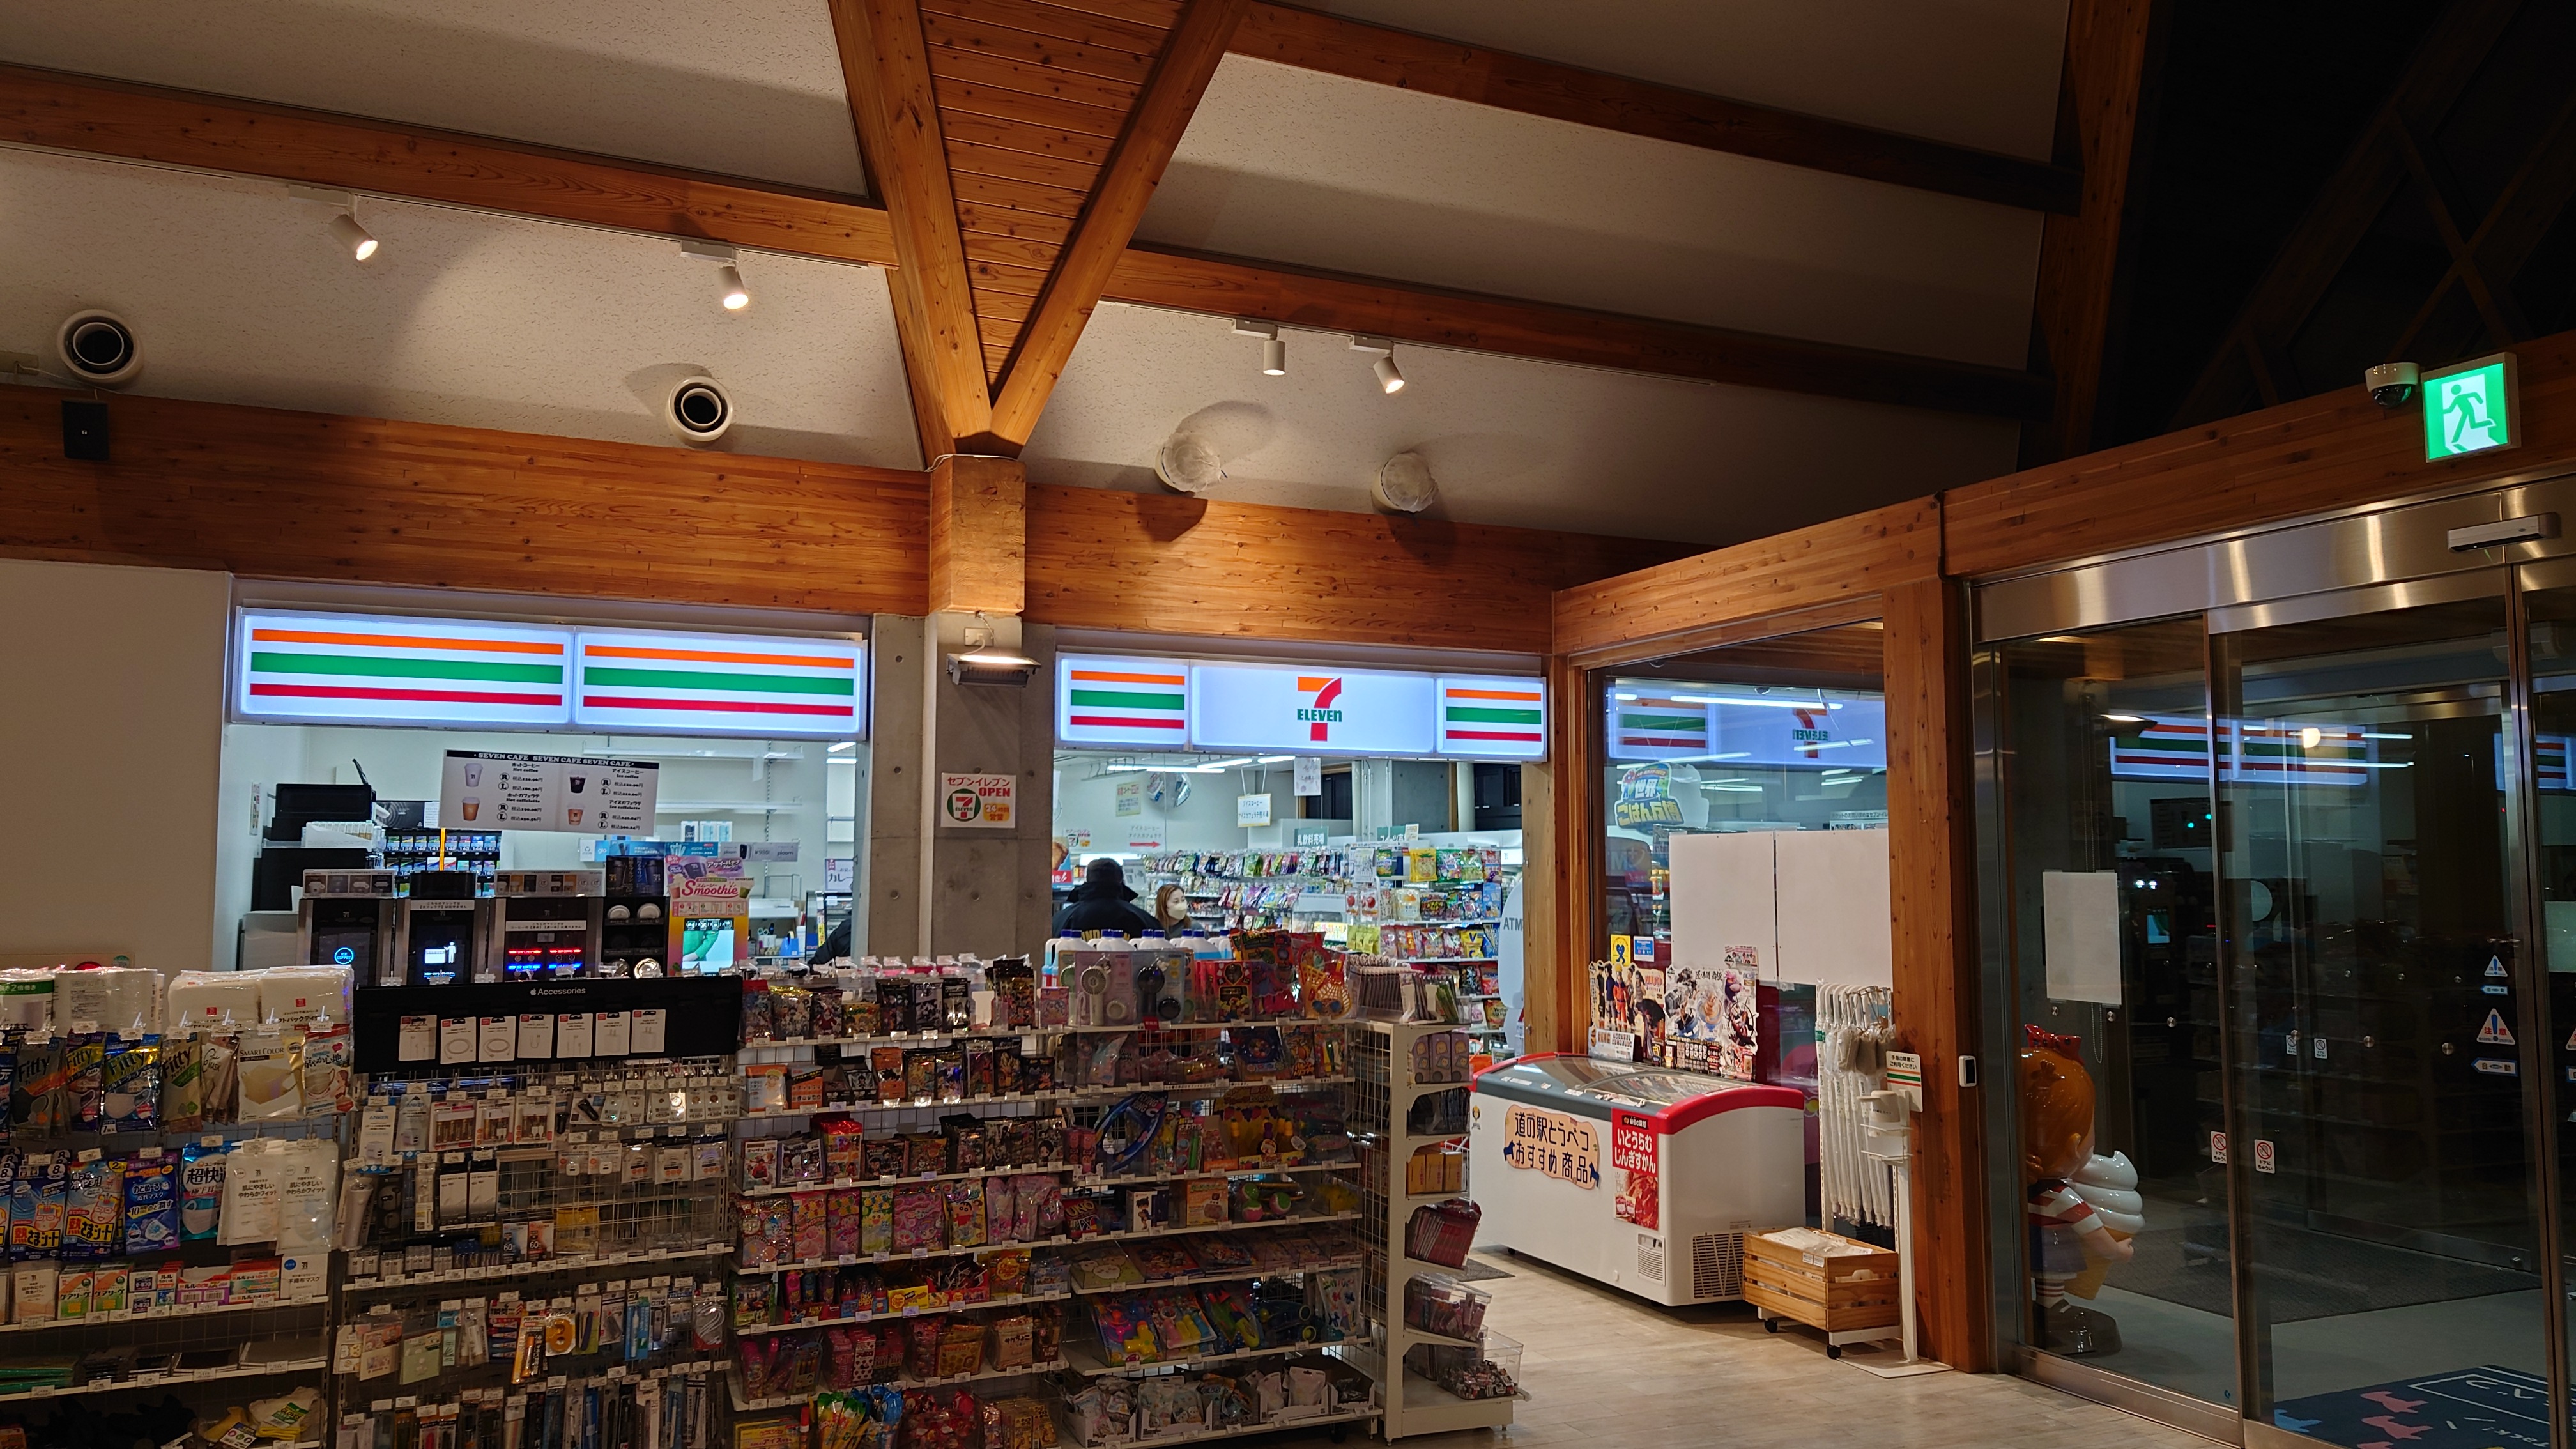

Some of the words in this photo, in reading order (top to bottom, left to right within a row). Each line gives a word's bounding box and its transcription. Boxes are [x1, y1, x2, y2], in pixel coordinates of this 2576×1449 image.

[947, 777, 1010, 786] セブンイレブン
[979, 787, 1011, 797] OPEN
[1635, 779, 1658, 799] 世界
[1617, 800, 1683, 826] ごはん万博
[1297, 832, 1324, 846] 乳飲料売場
[682, 880, 739, 896] Smoothie
[537, 986, 586, 995] Accessories
[2484, 1027, 2507, 1035] 注意
[65, 1048, 93, 1071] Fitty
[109, 1052, 145, 1077] Fitty
[161, 1046, 192, 1078] Fitty
[1889, 1061, 1917, 1070] ご利用ください
[2482, 1062, 2511, 1071] 自動
[18, 1054, 50, 1082] Fitty
[1138, 1092, 1160, 1110] FLYING
[1133, 1102, 1150, 1116] RING
[1617, 1128, 1653, 1153] いとうらむ
[1515, 1140, 1589, 1184] おすすめ商品
[1614, 1146, 1657, 1175] じんぎすかん
[137, 1192, 164, 1201] ぬれマスク
[238, 1190, 277, 1198] やわらかフィット
[286, 1187, 326, 1195] やわらかフィット
[1065, 1200, 1096, 1218] UNO
[68, 1217, 114, 1241] 熱さまシート
[14, 1227, 59, 1246] 熱さまシート
[503, 1243, 514, 1252] 60
[530, 1240, 539, 1249] 60
[60, 1291, 91, 1301] ケアリーヴ
[95, 1288, 125, 1297] ケアリーヴ
[858, 1297, 874, 1306] BABY
[280, 1406, 303, 1420] GLOVES
